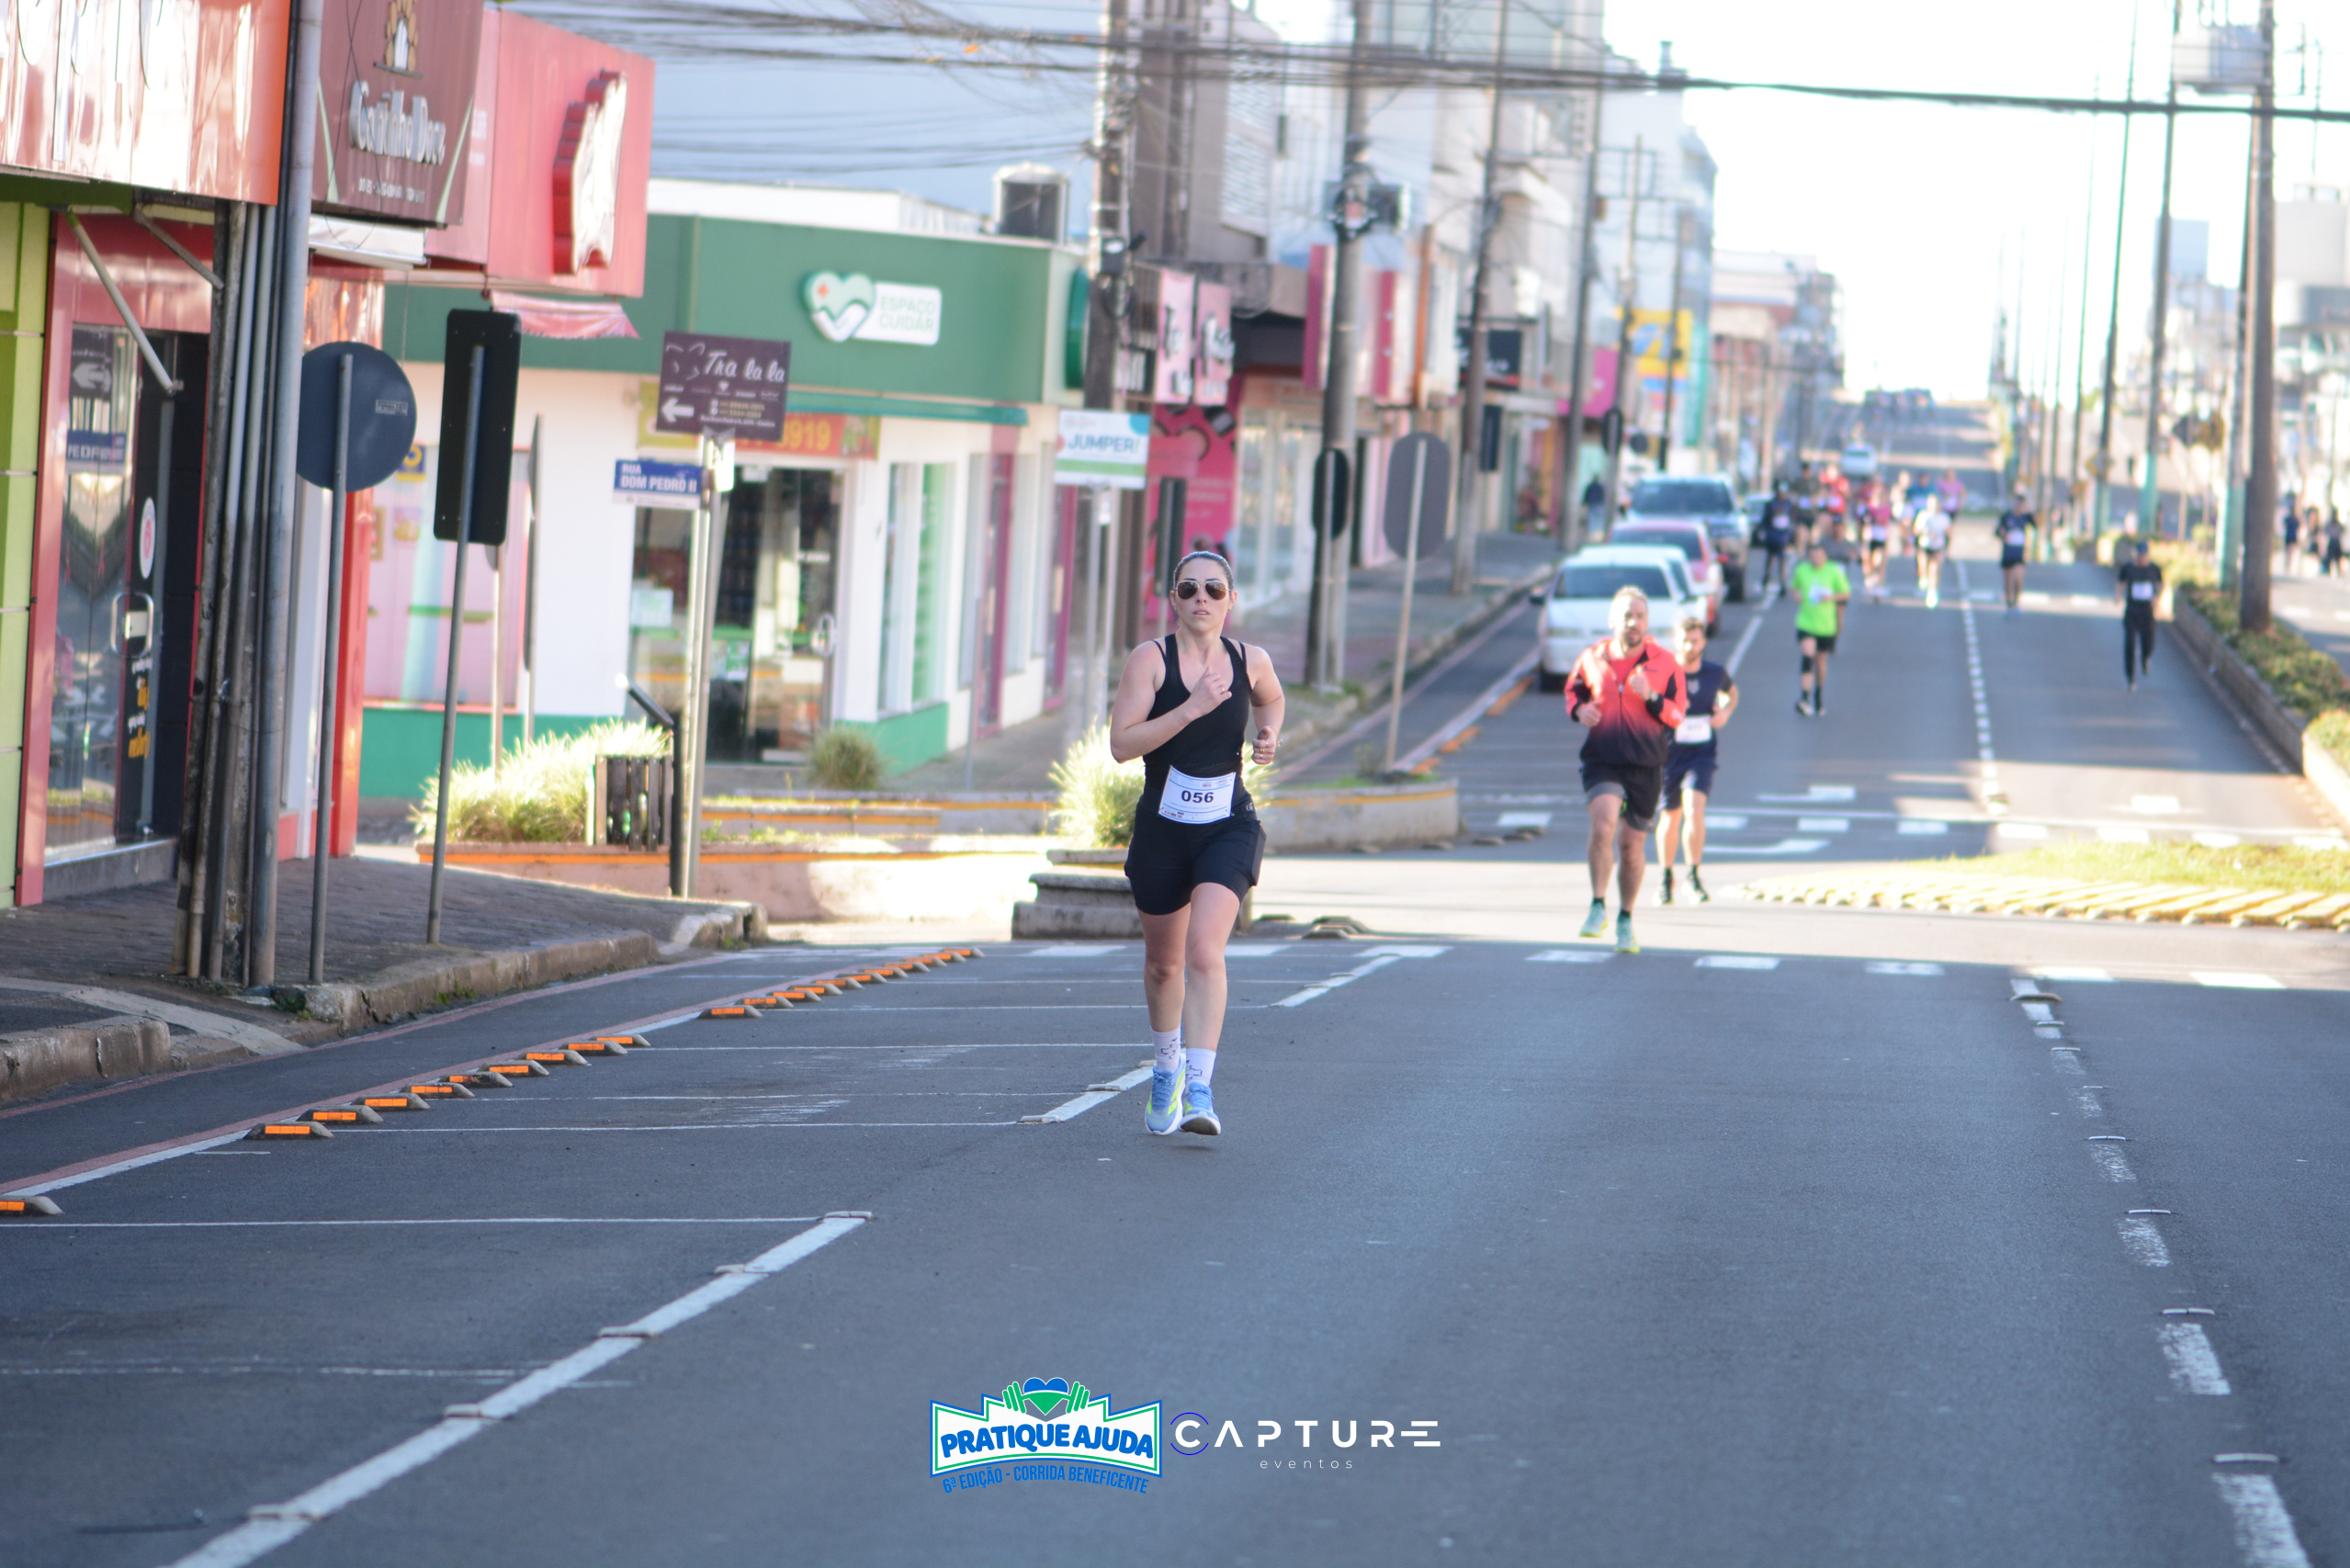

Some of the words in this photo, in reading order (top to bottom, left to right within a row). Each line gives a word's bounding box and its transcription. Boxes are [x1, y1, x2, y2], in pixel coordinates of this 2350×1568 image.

[880, 295, 936, 316] ESPAÇO
[879, 313, 935, 333] CUIDAR
[705, 351, 737, 378] Tra
[745, 357, 762, 381] la
[767, 359, 785, 383] la
[1068, 434, 1140, 454] JUMPER!
[621, 463, 642, 475] RUA
[620, 475, 648, 490] DOM
[650, 476, 687, 492] PEDRO
[688, 479, 697, 492] II
[1181, 790, 1214, 804] 056
